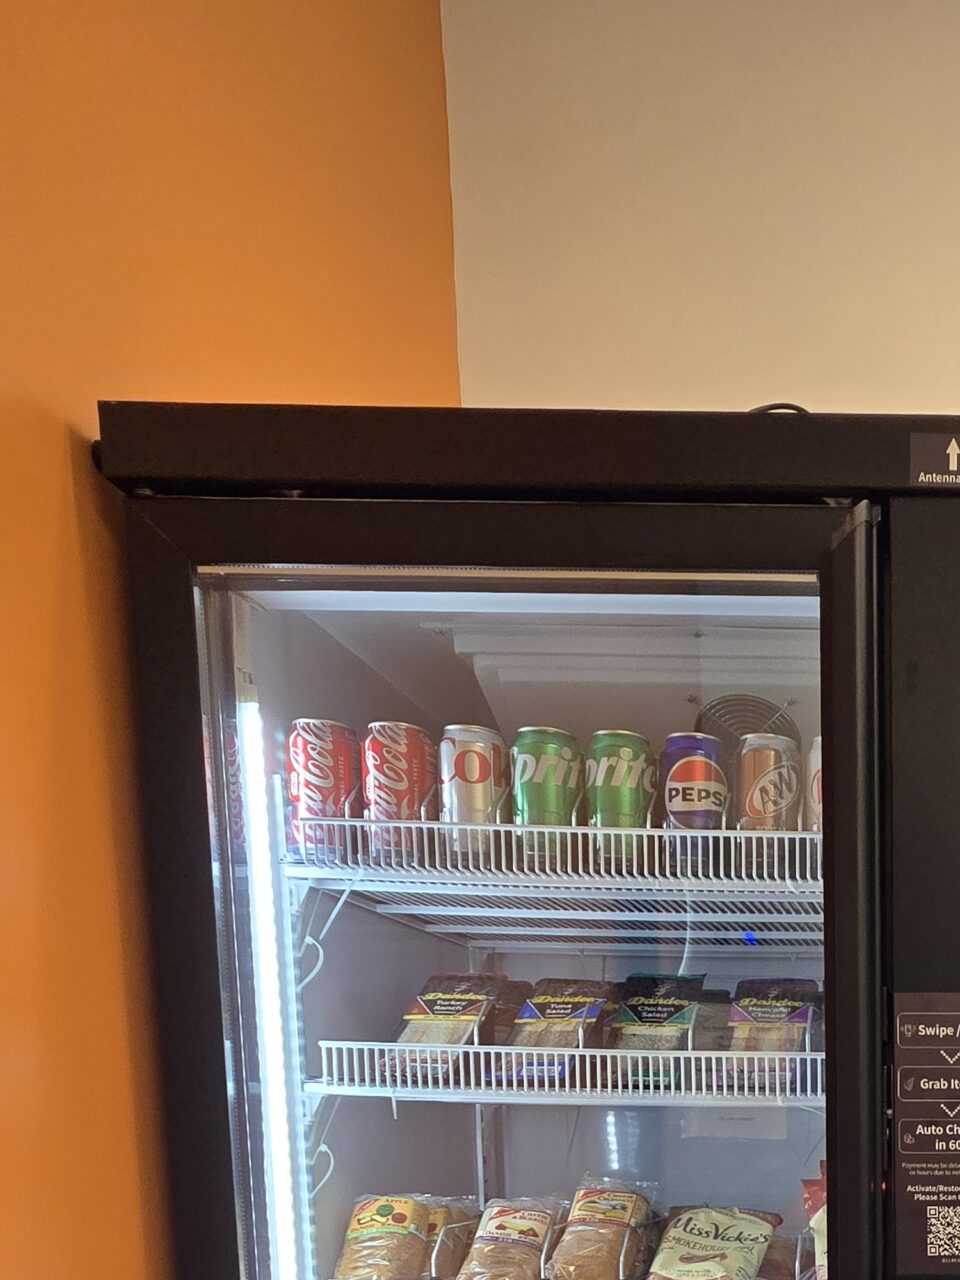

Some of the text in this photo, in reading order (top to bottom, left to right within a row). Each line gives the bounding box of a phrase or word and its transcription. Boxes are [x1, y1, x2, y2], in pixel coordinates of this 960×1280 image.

[436, 1000, 467, 1008] Turkey
[637, 1005, 675, 1013] Chicken
[641, 1011, 668, 1019] Salad
[918, 1023, 954, 1038] Swipe
[920, 1078, 948, 1089] Grab
[916, 1124, 944, 1135] Auto
[935, 1139, 947, 1151] in
[711, 1221, 771, 1245] Vickie's
